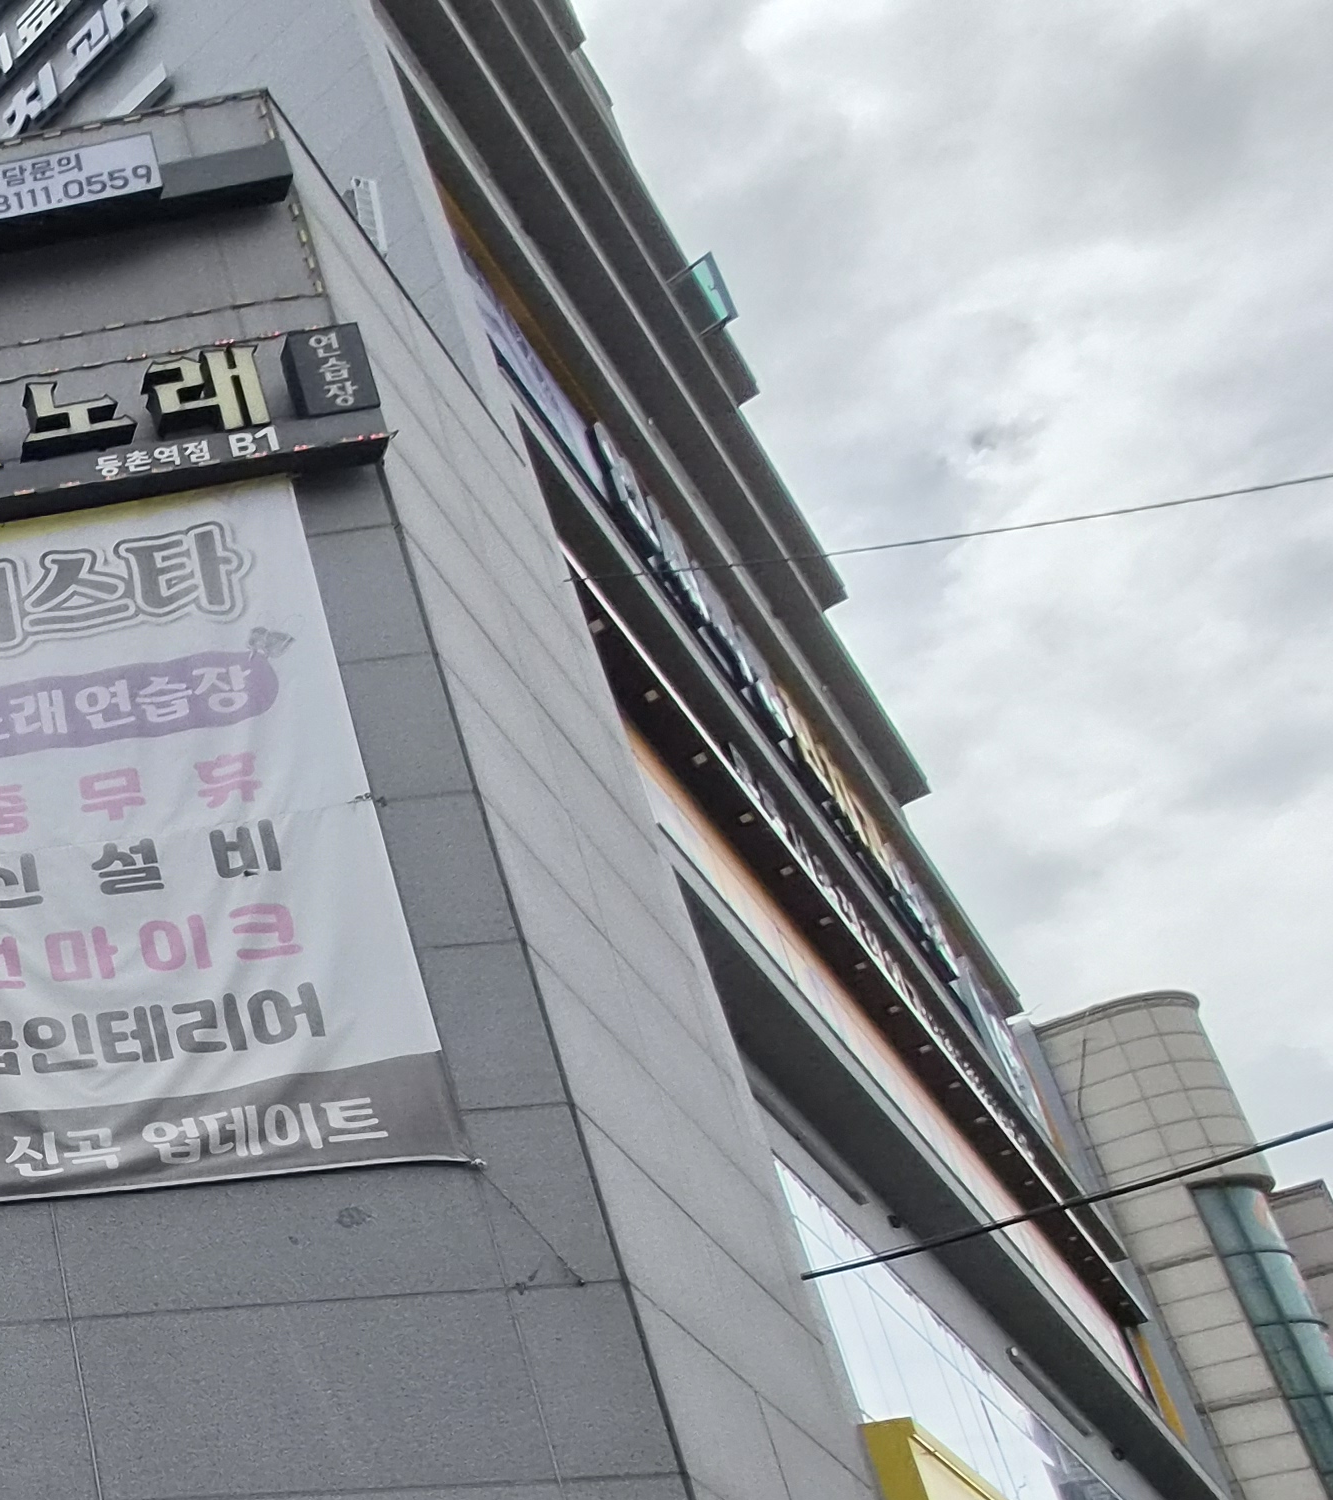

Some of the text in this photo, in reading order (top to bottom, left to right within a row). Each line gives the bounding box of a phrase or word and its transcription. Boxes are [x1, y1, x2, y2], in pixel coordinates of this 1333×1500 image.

[95, 425, 281, 477] 등촌역점 B1
[5, 1127, 123, 1178] 신곡
[142, 1097, 389, 1165] 업데이트
